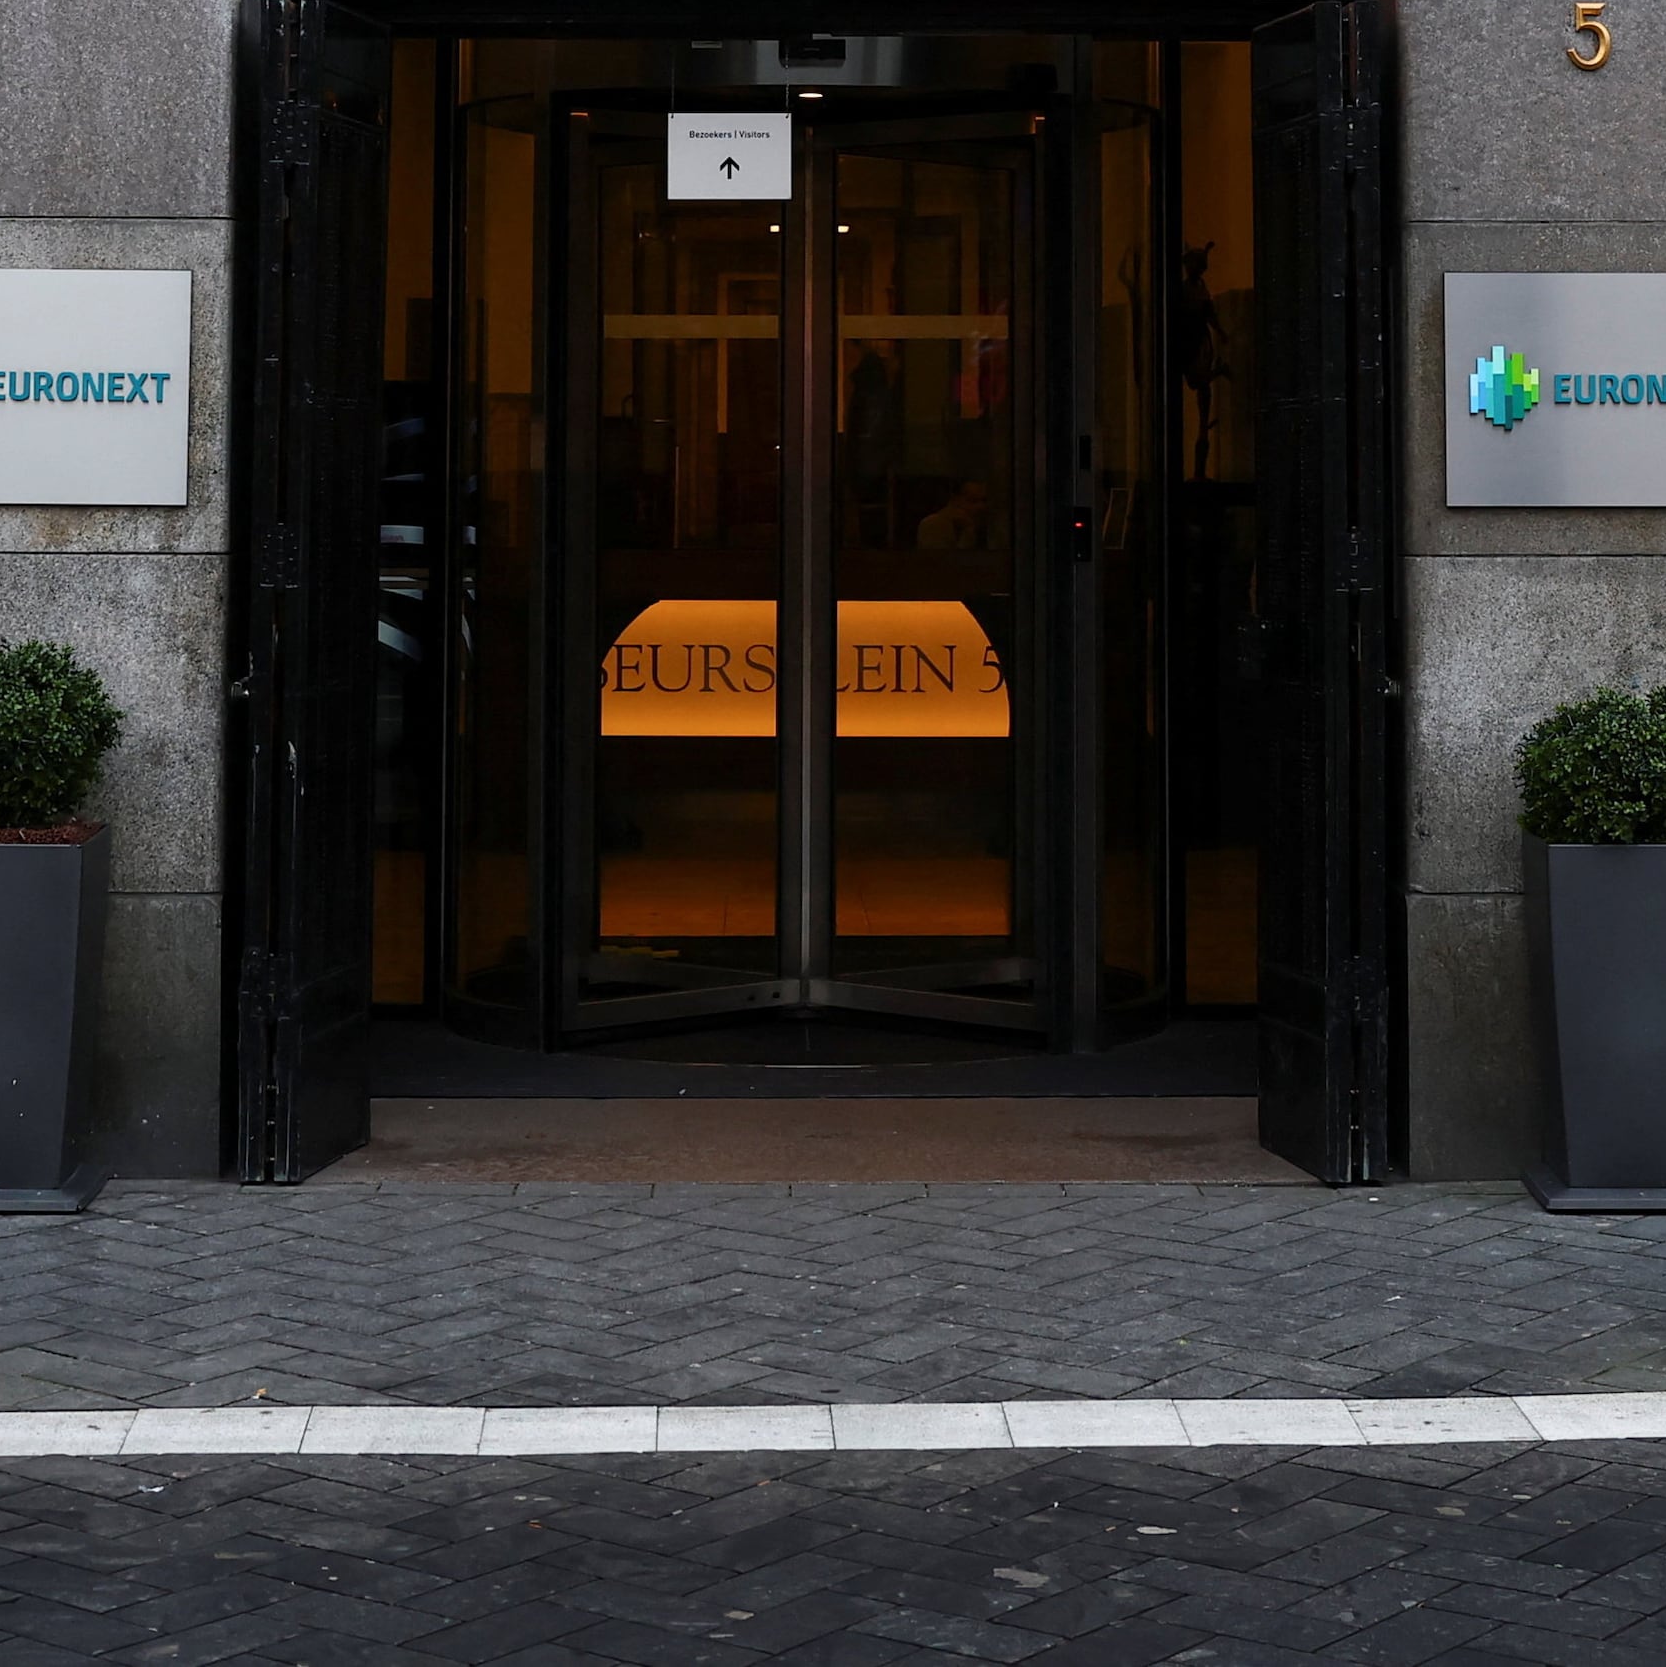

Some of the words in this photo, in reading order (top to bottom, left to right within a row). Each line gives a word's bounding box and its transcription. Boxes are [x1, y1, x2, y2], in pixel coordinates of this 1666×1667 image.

[1566, 2, 1613, 71] 5
[689, 130, 732, 139] Bezoekers
[738, 130, 770, 139] Visitors
